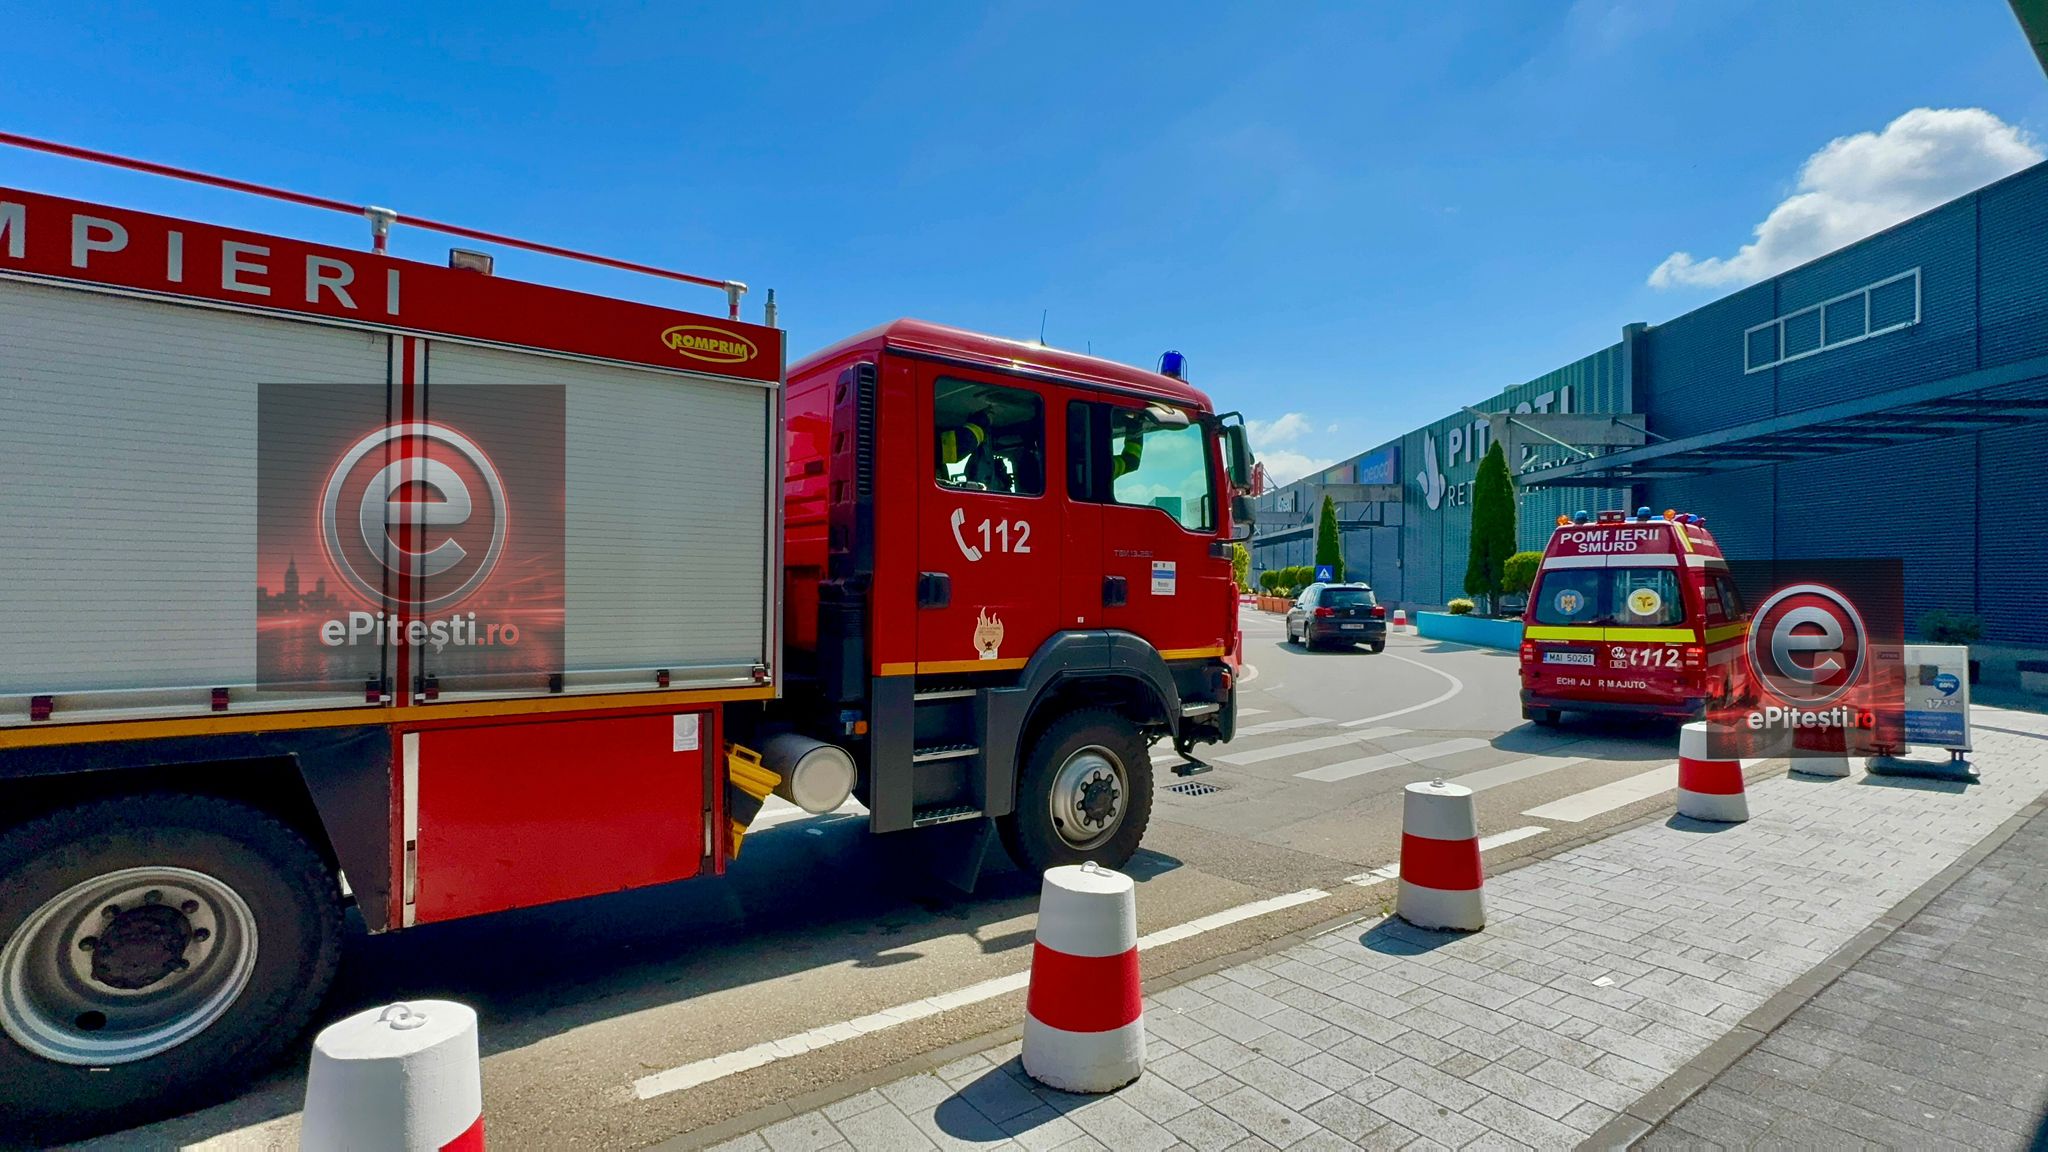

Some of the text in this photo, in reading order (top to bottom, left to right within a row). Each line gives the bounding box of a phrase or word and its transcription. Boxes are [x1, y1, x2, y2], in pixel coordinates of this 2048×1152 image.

[671, 332, 748, 357] ROMPRIM
[977, 518, 1031, 553] 112
[1578, 541, 1638, 553] SMURD
[1549, 653, 1592, 663] MAI 50261
[1639, 648, 1680, 667] 112
